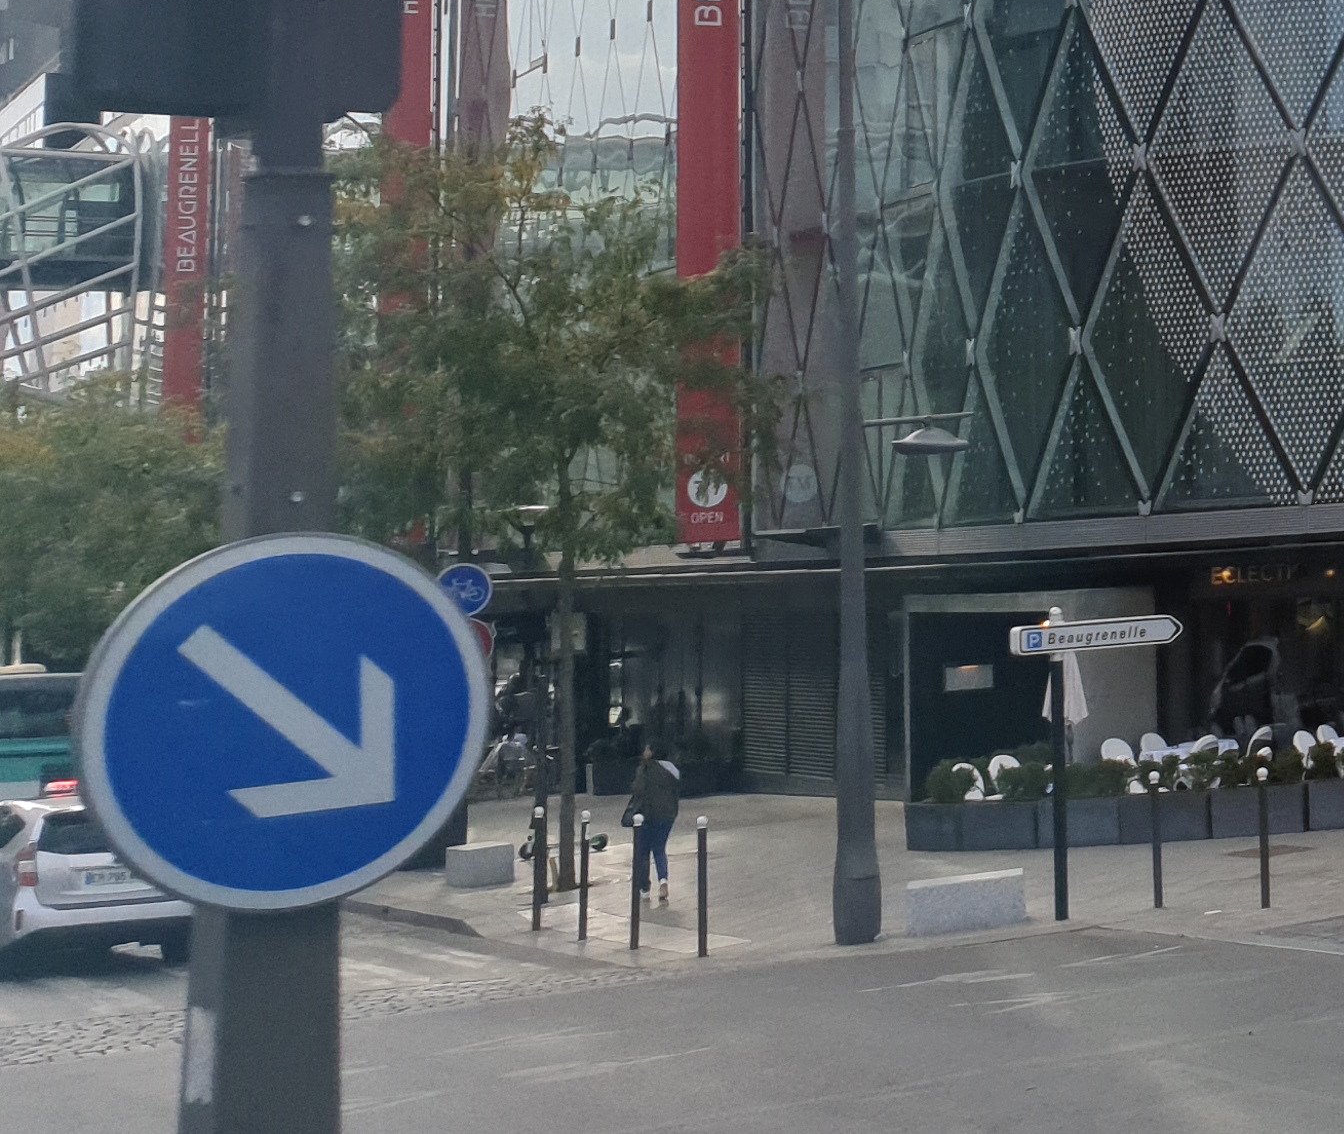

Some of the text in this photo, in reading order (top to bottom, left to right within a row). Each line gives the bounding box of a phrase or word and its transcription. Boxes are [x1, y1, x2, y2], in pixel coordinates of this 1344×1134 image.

[176, 118, 200, 273] BEAUGRENELL
[690, 511, 724, 524] OPEN
[1029, 626, 1147, 648] P Beaugrenelle
